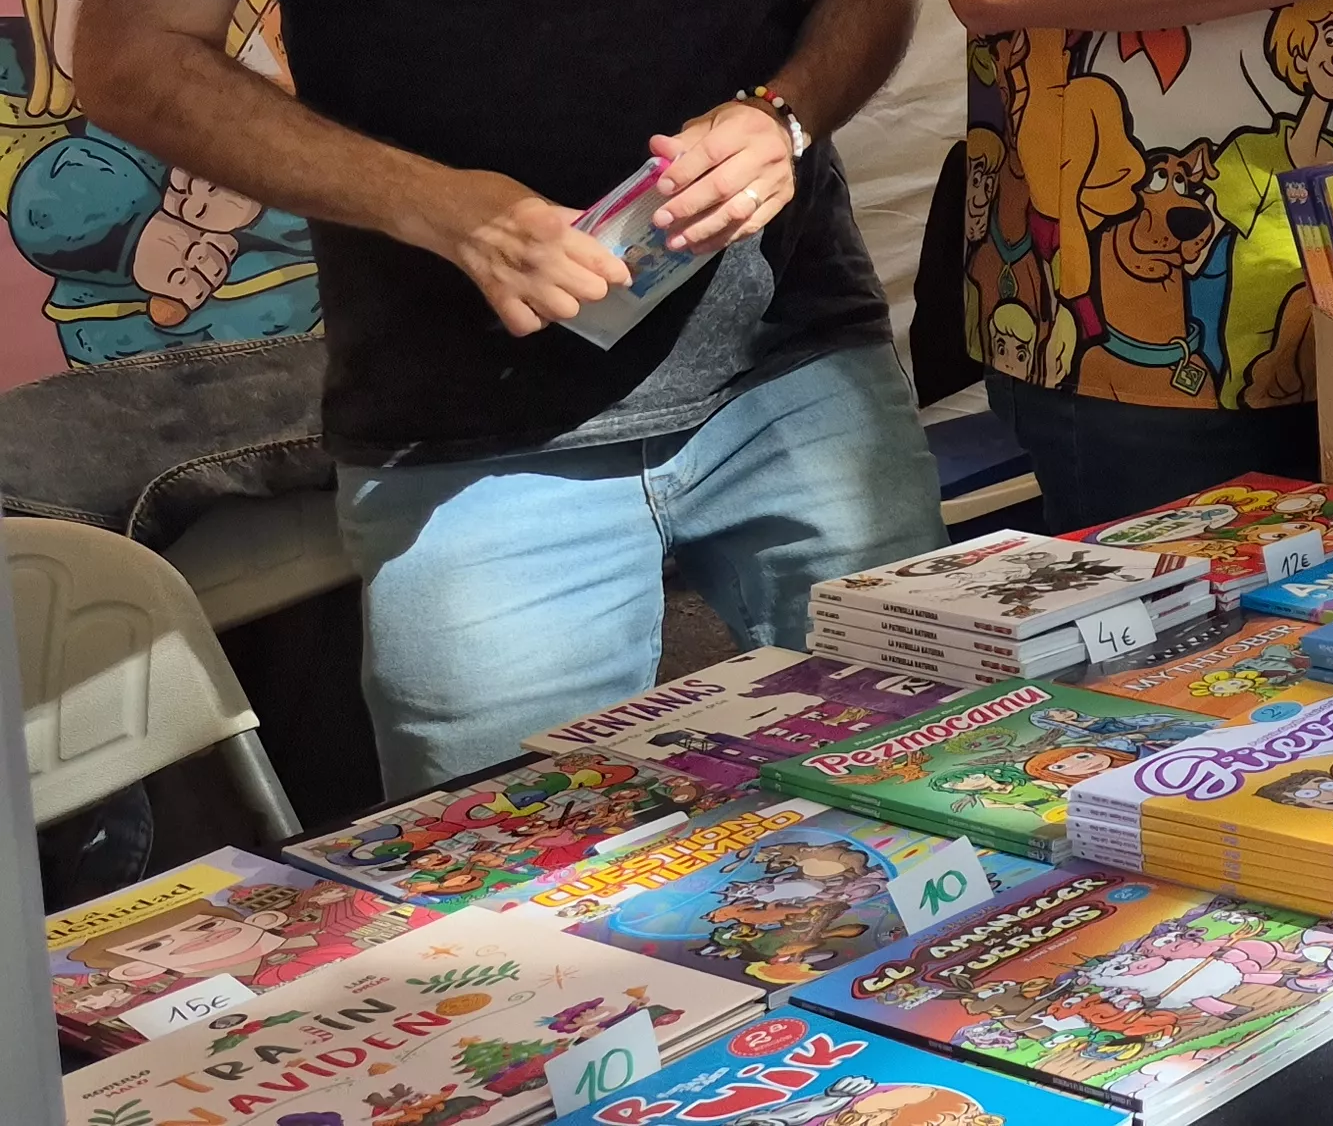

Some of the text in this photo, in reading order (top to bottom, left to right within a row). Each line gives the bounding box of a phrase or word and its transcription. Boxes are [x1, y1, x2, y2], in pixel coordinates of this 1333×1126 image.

[1281, 553, 1310, 576] 12€
[1099, 621, 1136, 654] 4€
[1124, 624, 1298, 693] MYTHTOBER
[548, 679, 726, 744] VENTANAS
[808, 685, 1049, 774] Pezmocamu
[627, 810, 804, 890] TIEMPO
[47, 883, 197, 941] dentidad
[919, 869, 968, 916] 10
[929, 876, 1107, 959] AMANECER
[939, 905, 1102, 979] PUERCOS
[168, 994, 232, 1024] 15€
[575, 1047, 634, 1106] 10
